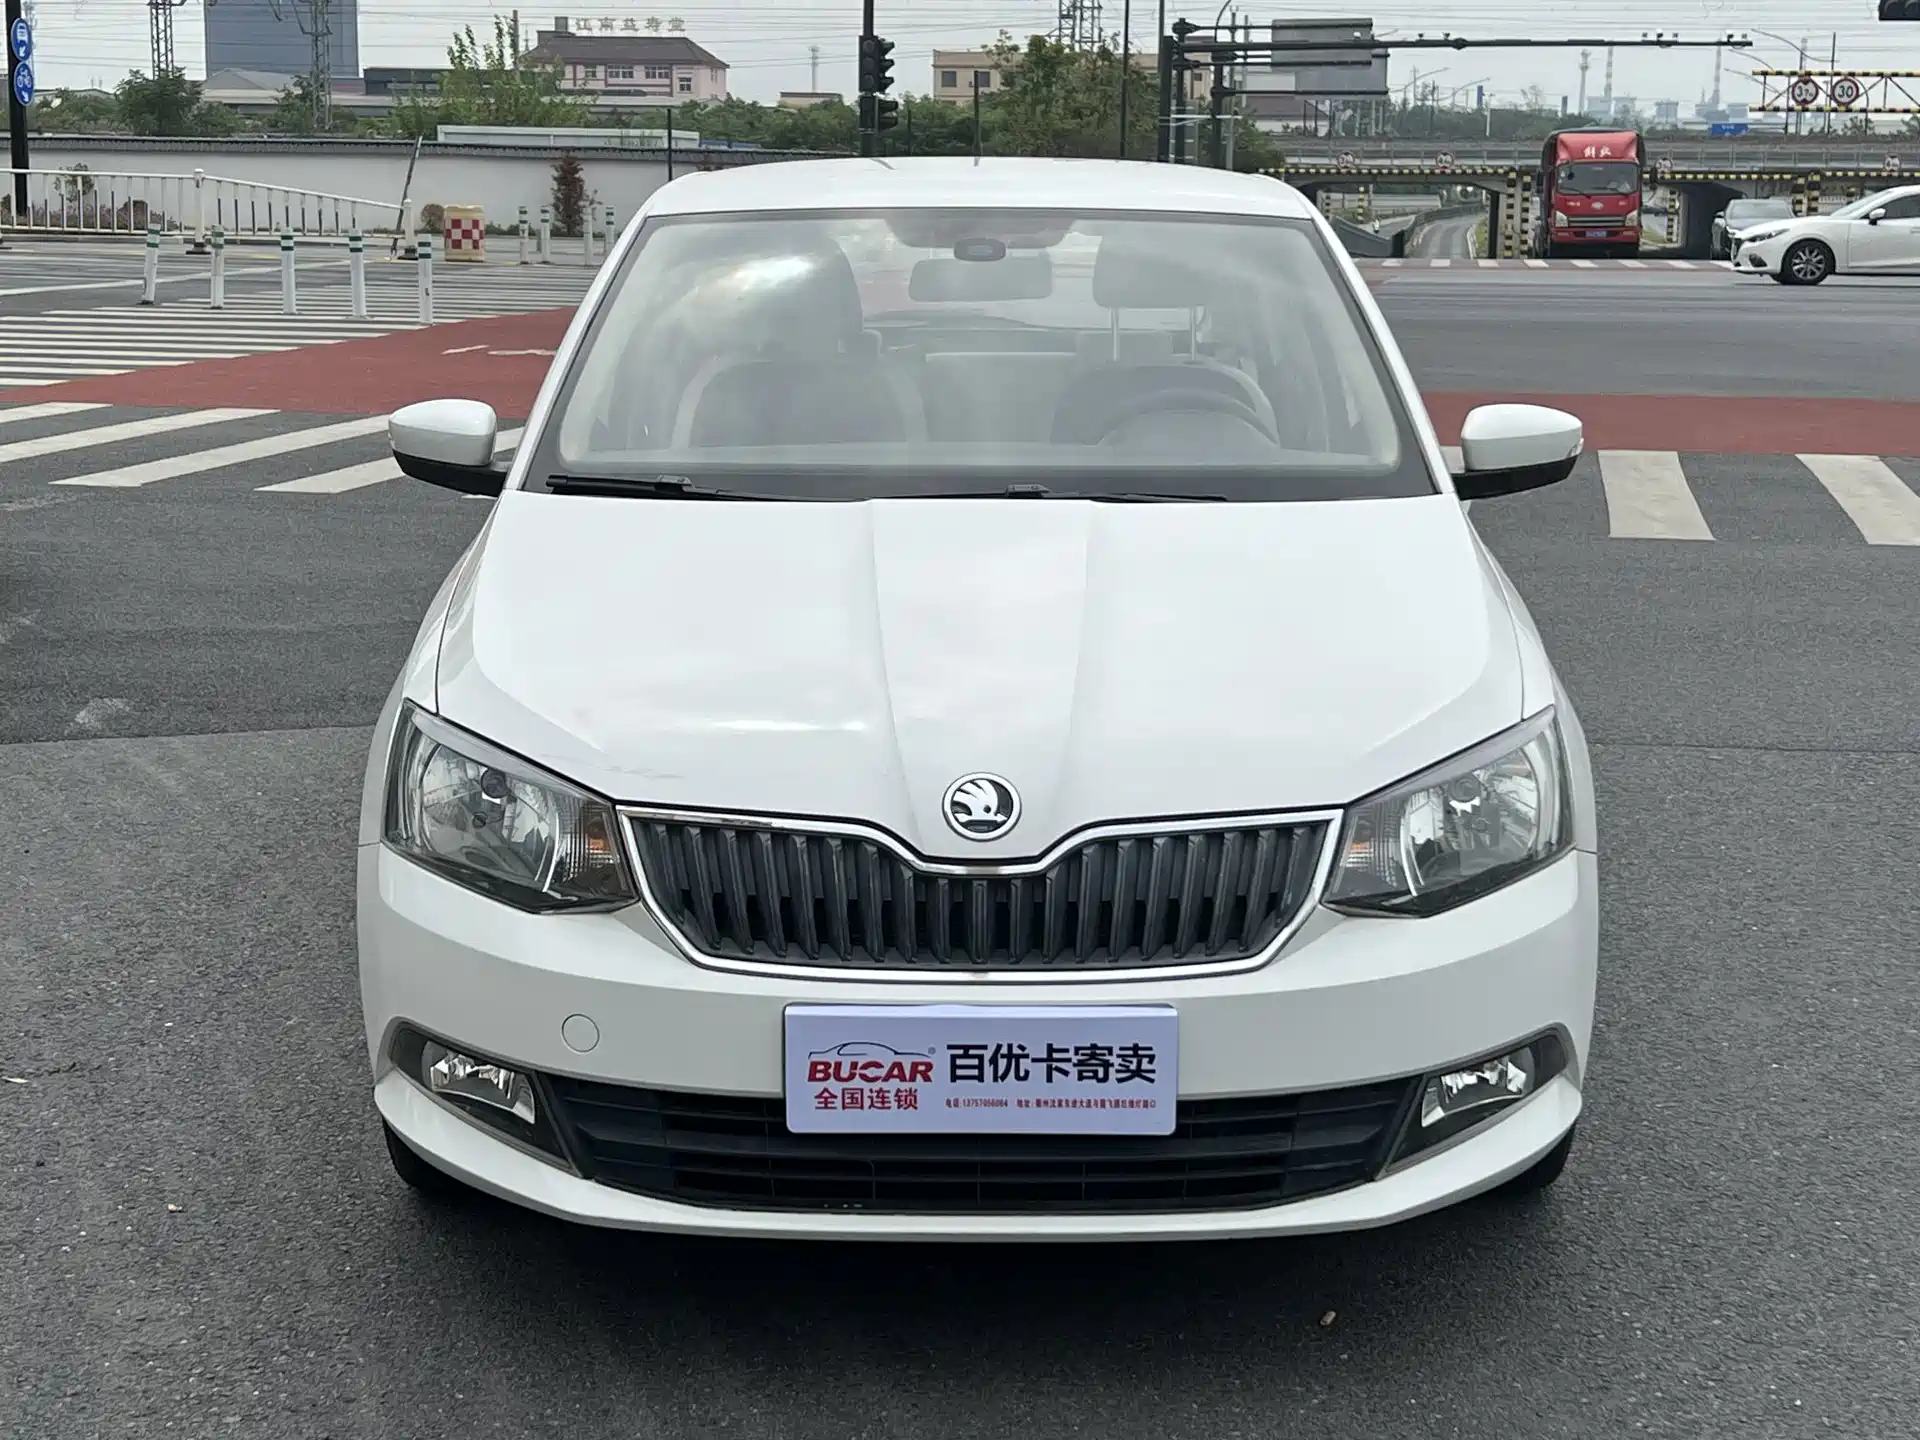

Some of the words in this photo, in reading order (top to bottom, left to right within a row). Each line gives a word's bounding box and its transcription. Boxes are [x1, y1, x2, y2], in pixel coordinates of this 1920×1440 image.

[1838, 85, 1854, 98] 30
[807, 1060, 934, 1083] BUCAR
[946, 1042, 1157, 1084] 百优卡寄卖
[814, 1087, 919, 1111] 全国连锁
